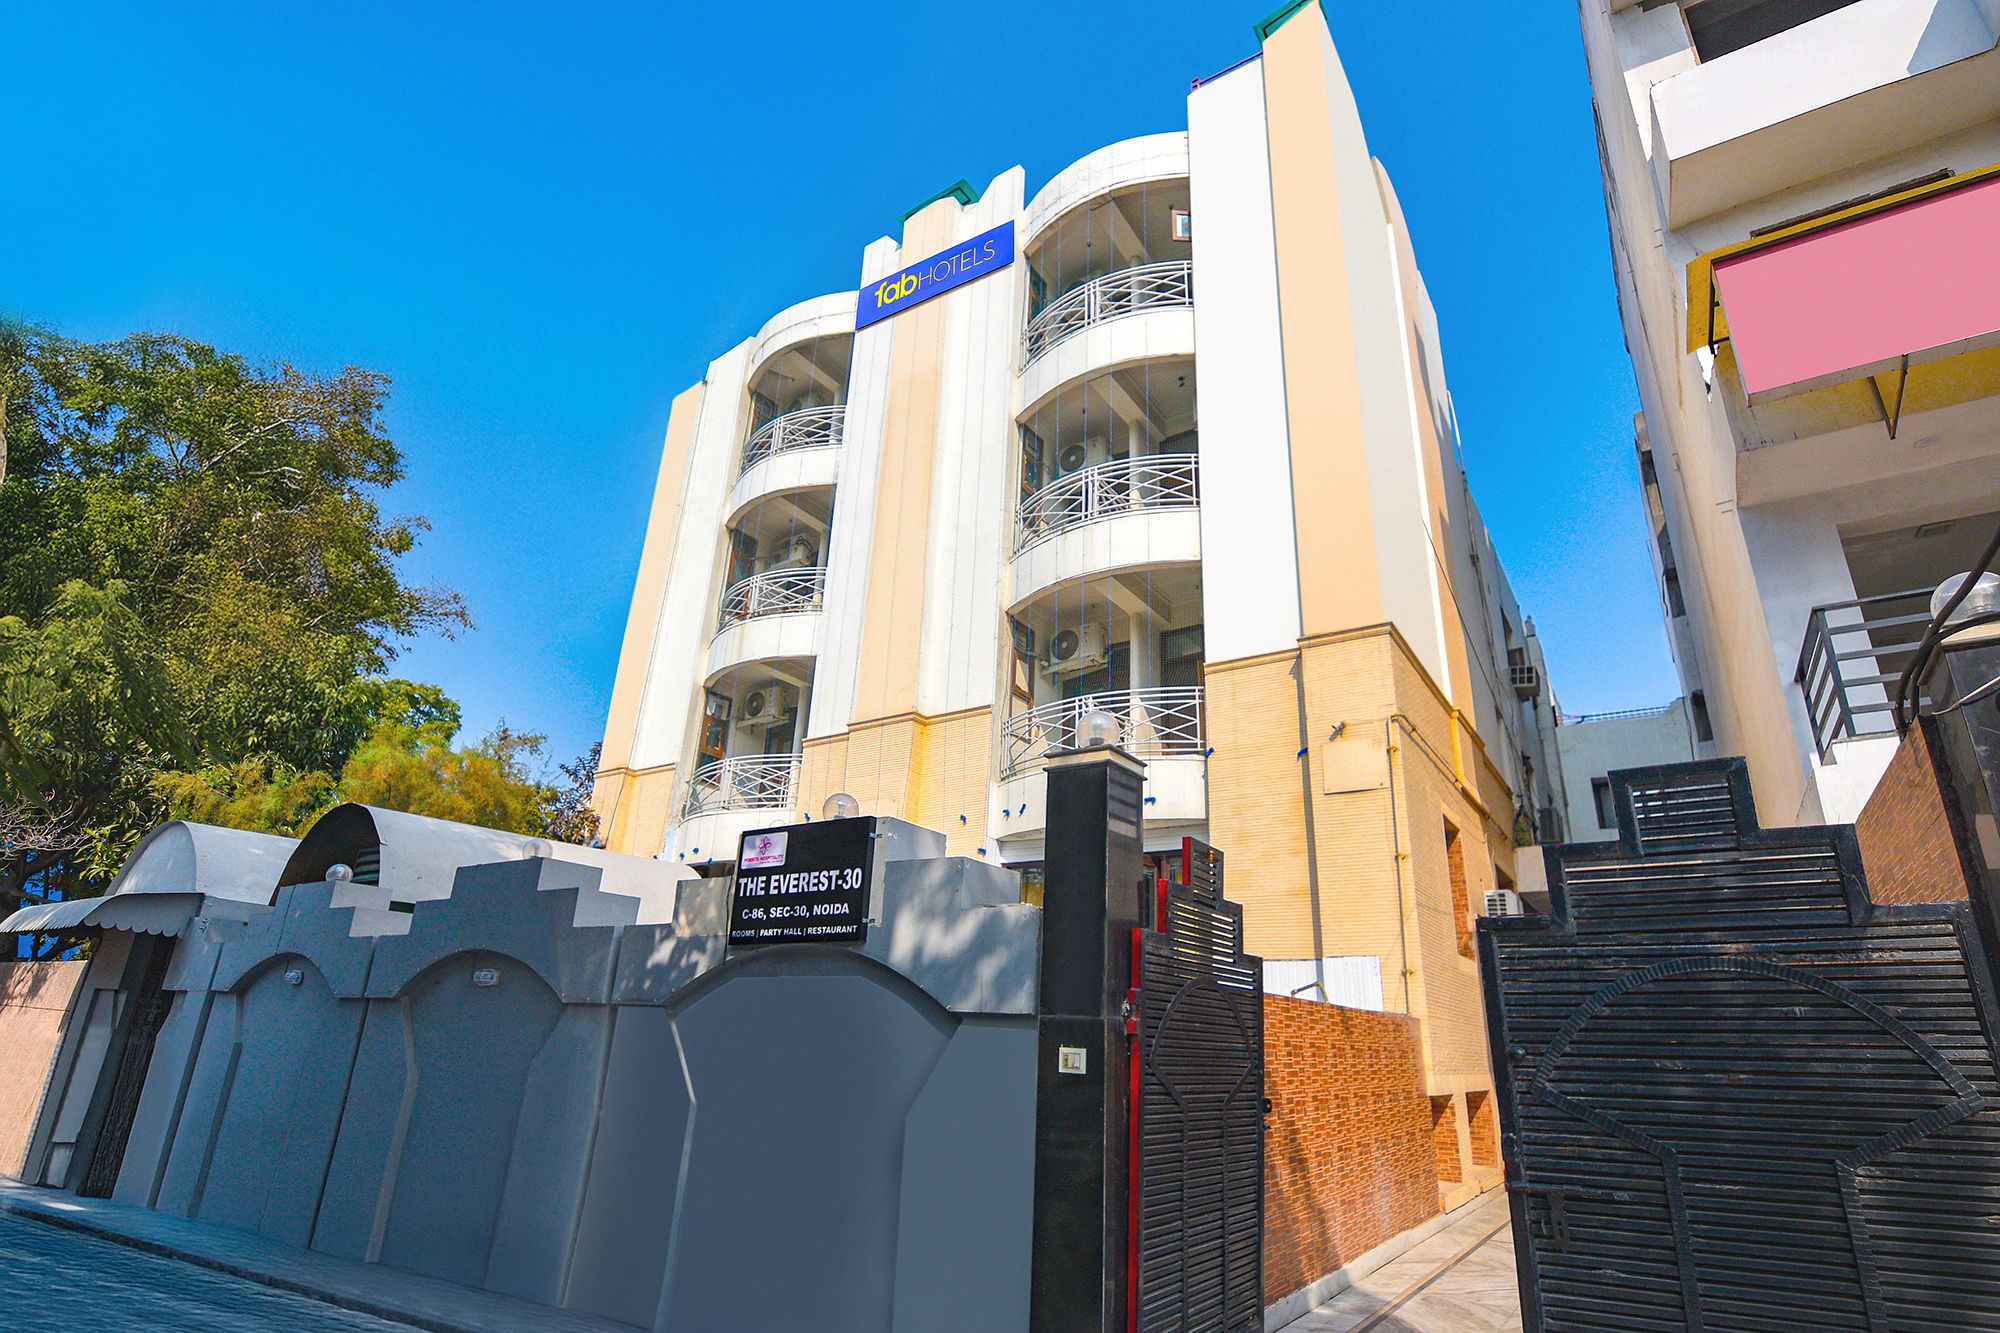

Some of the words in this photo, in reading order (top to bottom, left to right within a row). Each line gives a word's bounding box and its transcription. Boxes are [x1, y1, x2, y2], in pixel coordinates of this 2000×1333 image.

[738, 876, 767, 897] THE
[769, 867, 862, 895] EVEREST-30
[742, 908, 767, 920] C-86,
[769, 905, 810, 918] SEC-30,
[812, 903, 850, 916] NOIDA
[731, 929, 755, 938] ROOMS
[807, 925, 858, 935] RESTAURANT
